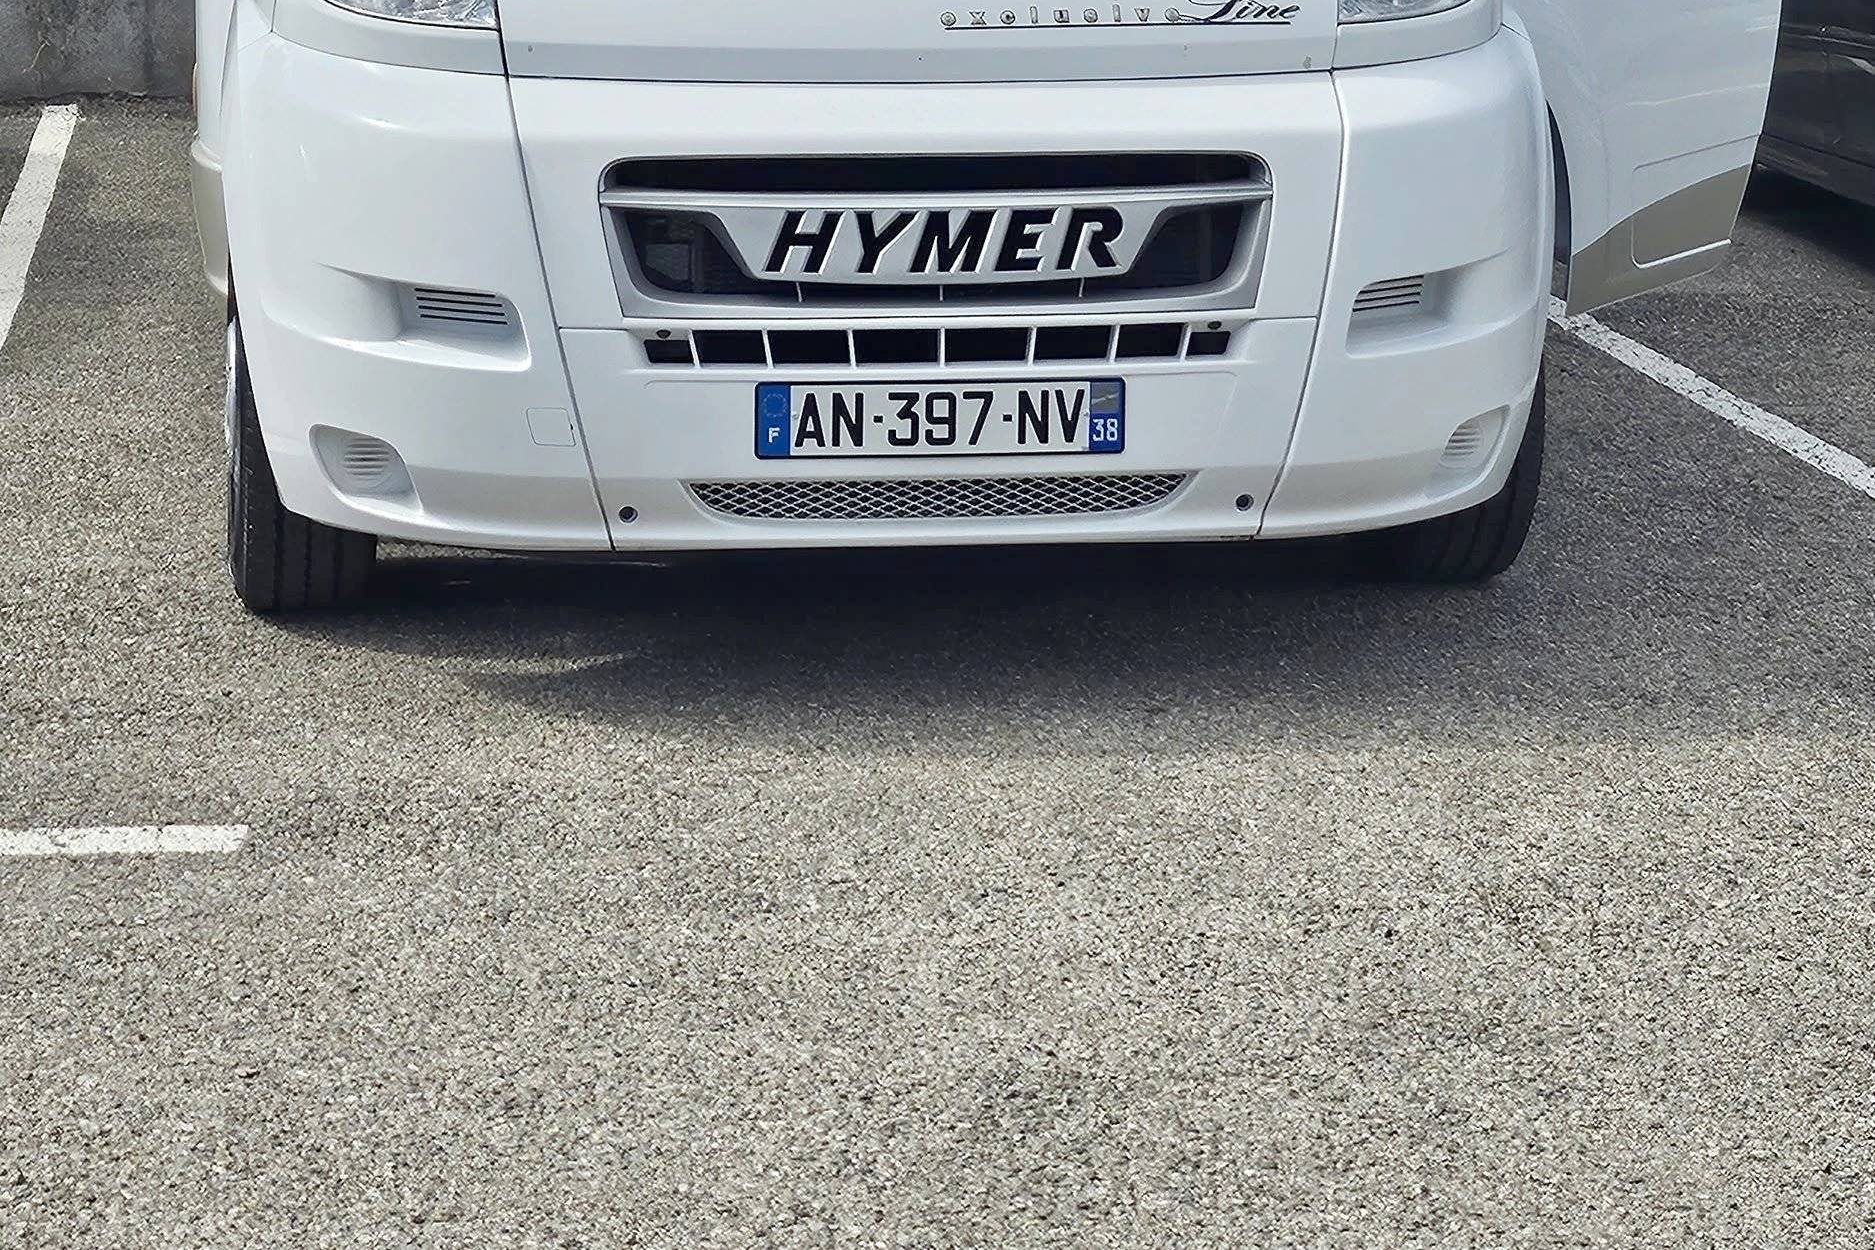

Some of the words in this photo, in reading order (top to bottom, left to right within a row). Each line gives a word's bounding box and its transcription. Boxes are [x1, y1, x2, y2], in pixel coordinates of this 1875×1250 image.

[764, 207, 1124, 274] HYMER
[767, 427, 781, 443] F
[1091, 418, 1119, 442] 38
